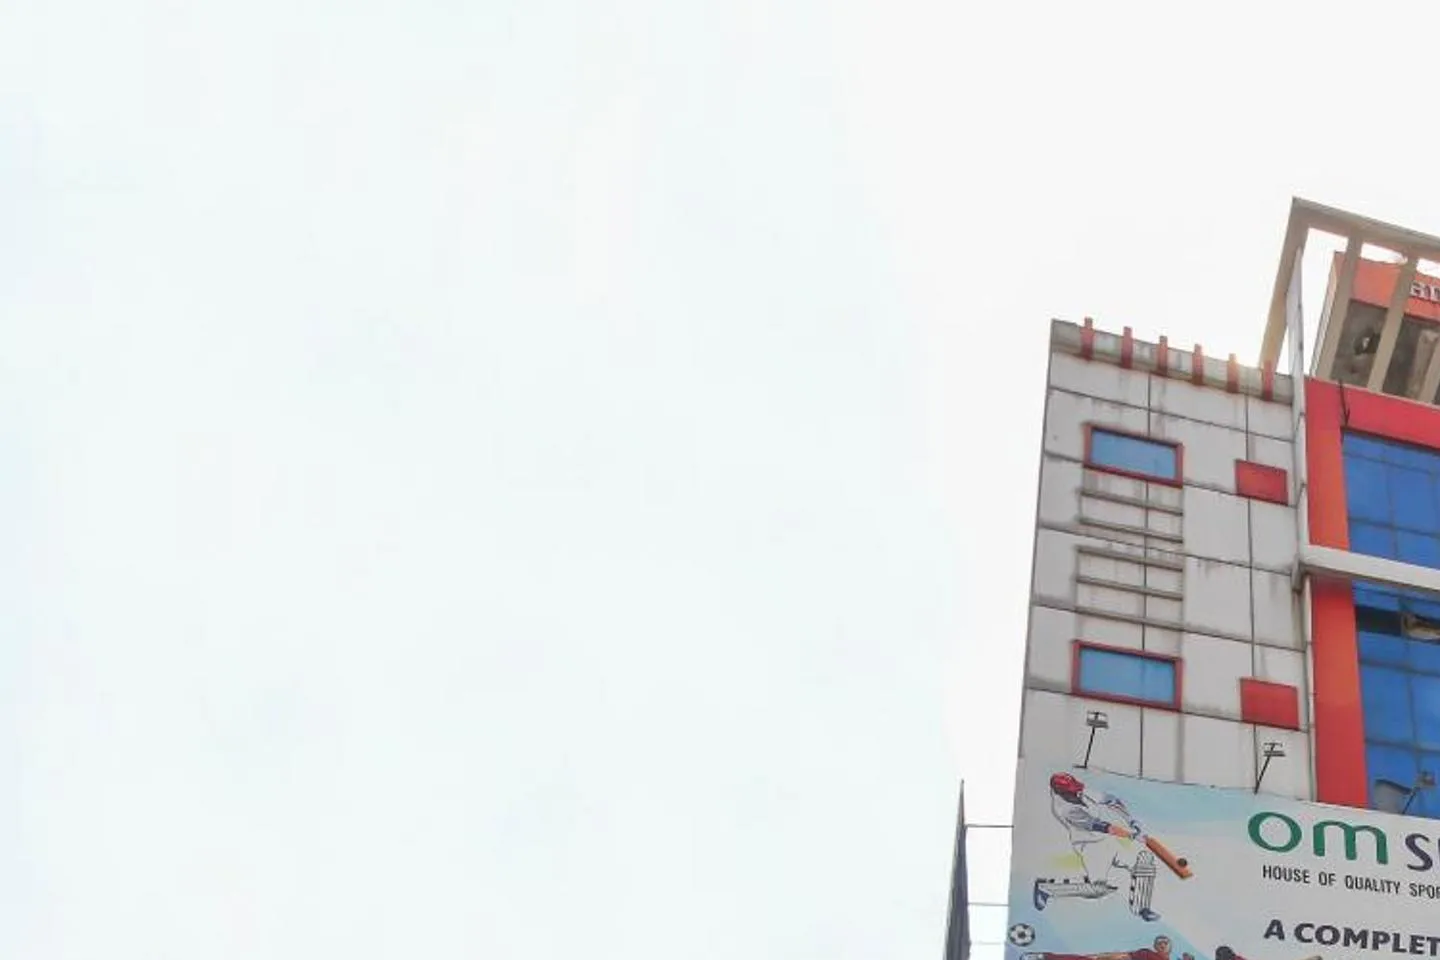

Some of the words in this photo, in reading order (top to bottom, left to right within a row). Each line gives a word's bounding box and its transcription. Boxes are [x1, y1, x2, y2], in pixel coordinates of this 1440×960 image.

[1262, 864, 1311, 885] HOUSE
[1318, 871, 1336, 887] OF
[1344, 874, 1402, 896] QUALITY
[1263, 918, 1286, 941] A
